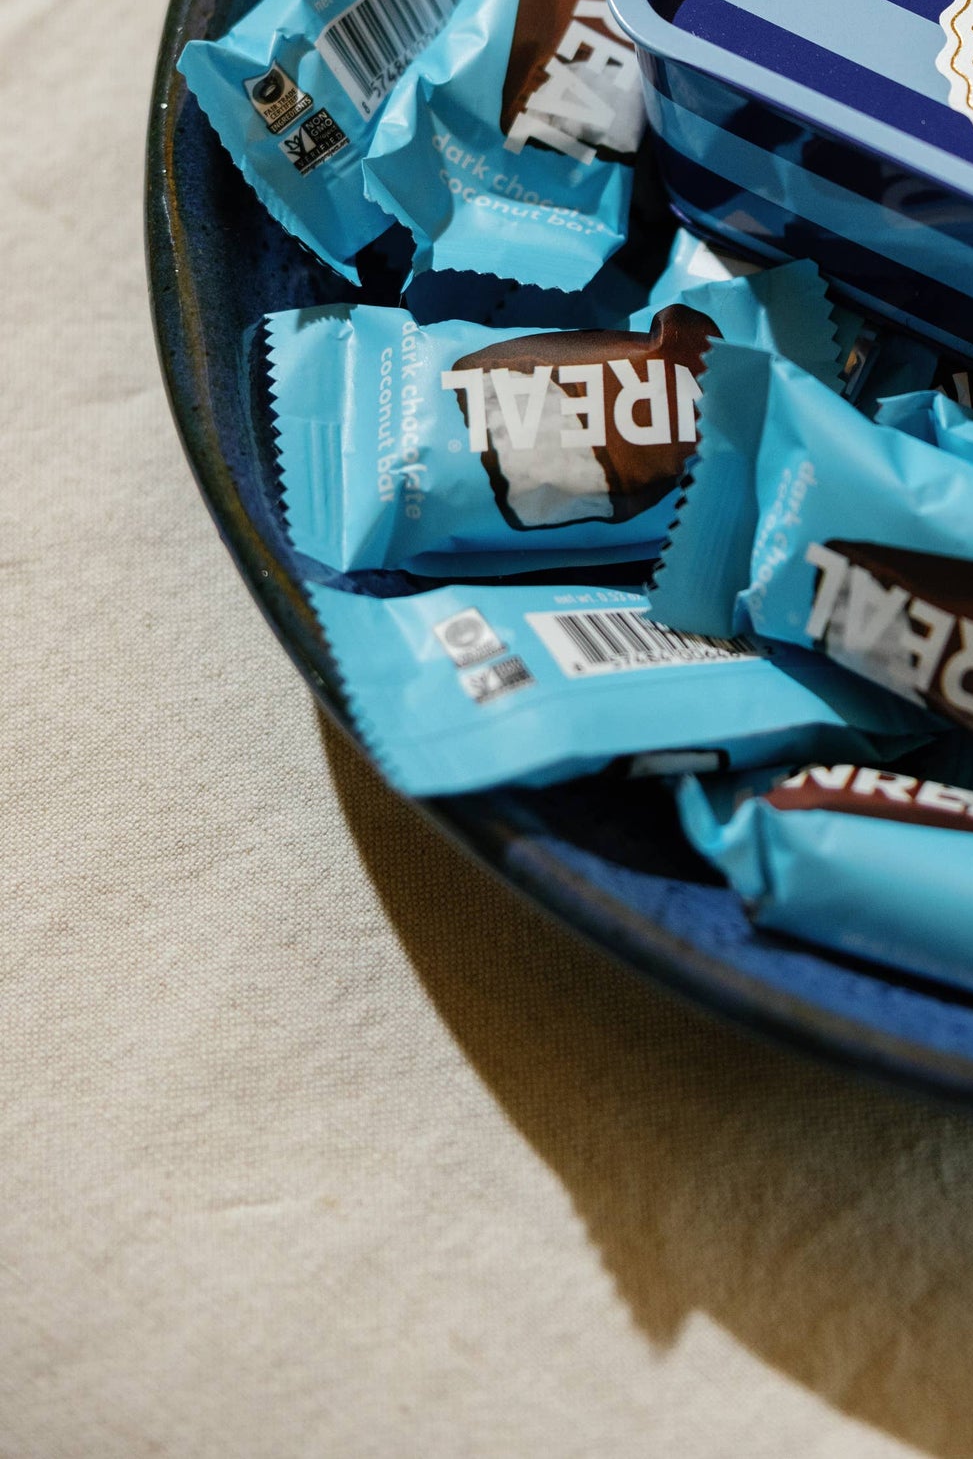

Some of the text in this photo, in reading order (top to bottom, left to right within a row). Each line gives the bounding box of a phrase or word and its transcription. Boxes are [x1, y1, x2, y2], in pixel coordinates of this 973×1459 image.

[264, 88, 298, 118] FAIR TRADE
[270, 97, 312, 132] INGREDIENTS
[305, 111, 328, 129] NON
[310, 118, 333, 137] GMO
[299, 133, 343, 166] VERIFIED
[432, 133, 490, 179] dark
[439, 168, 593, 235] coconut bar
[402, 320, 429, 380] dark
[377, 347, 399, 503] coconut bar
